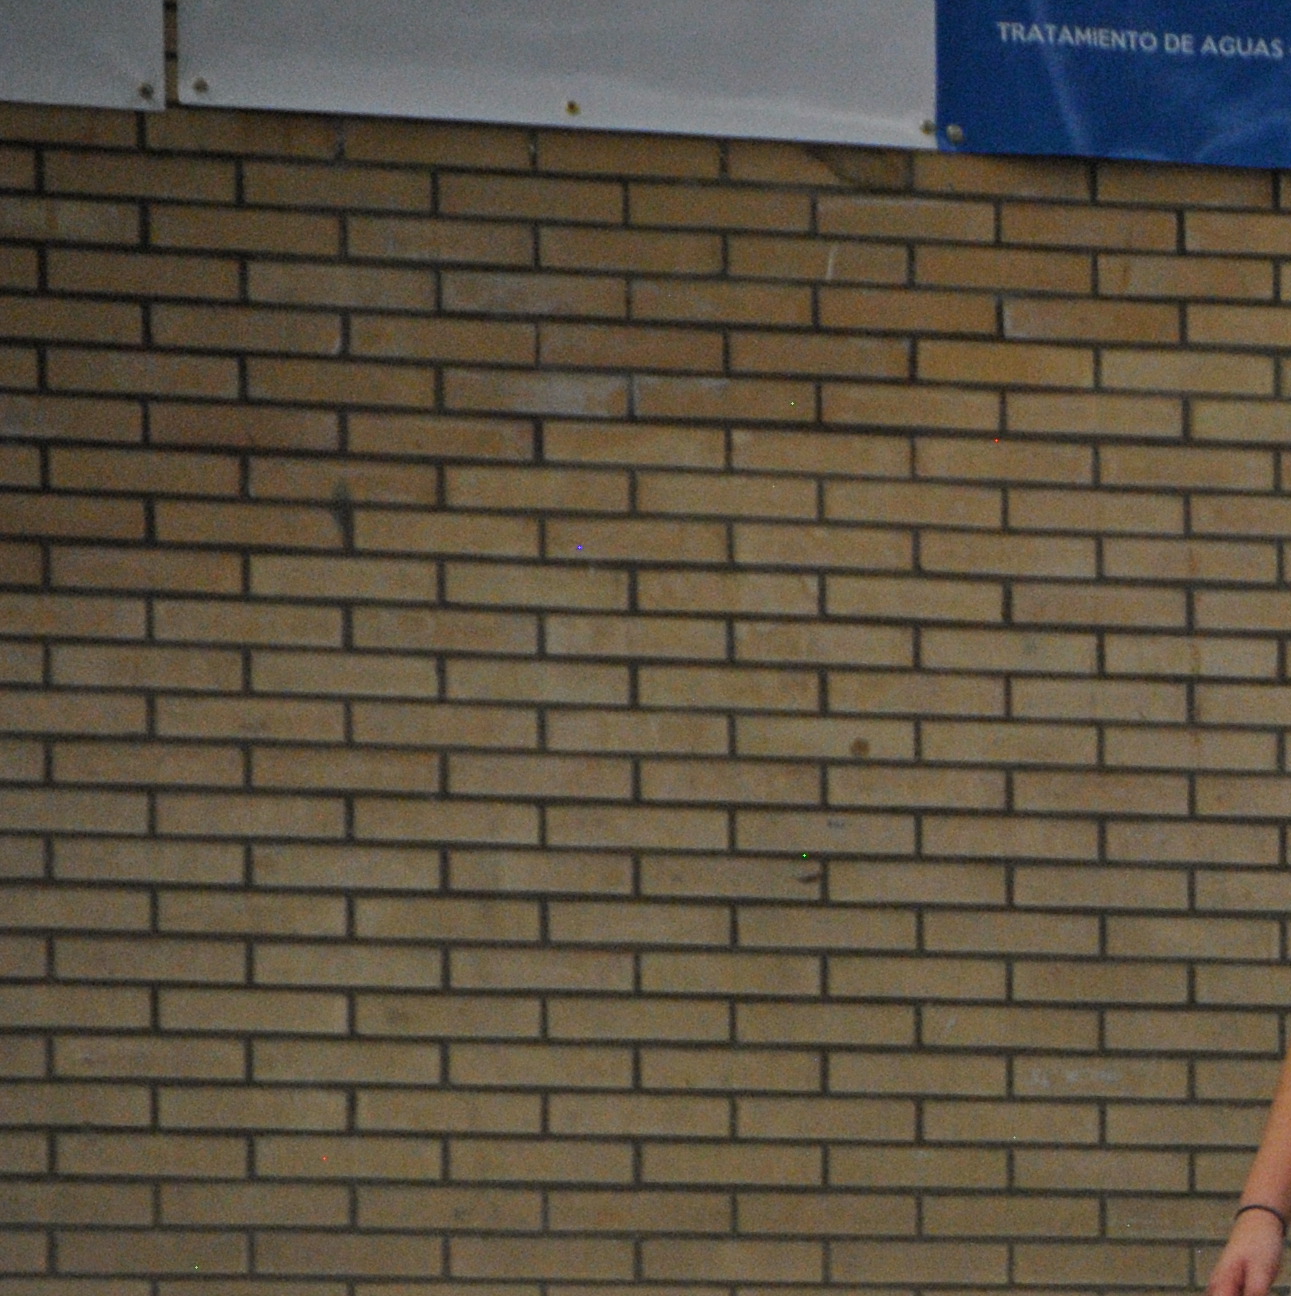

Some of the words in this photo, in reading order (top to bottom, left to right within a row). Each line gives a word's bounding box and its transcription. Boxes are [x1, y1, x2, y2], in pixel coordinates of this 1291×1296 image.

[997, 21, 1157, 51] TRATAMIENTO
[1164, 33, 1194, 55] DE
[1201, 35, 1284, 59] AGUAS
